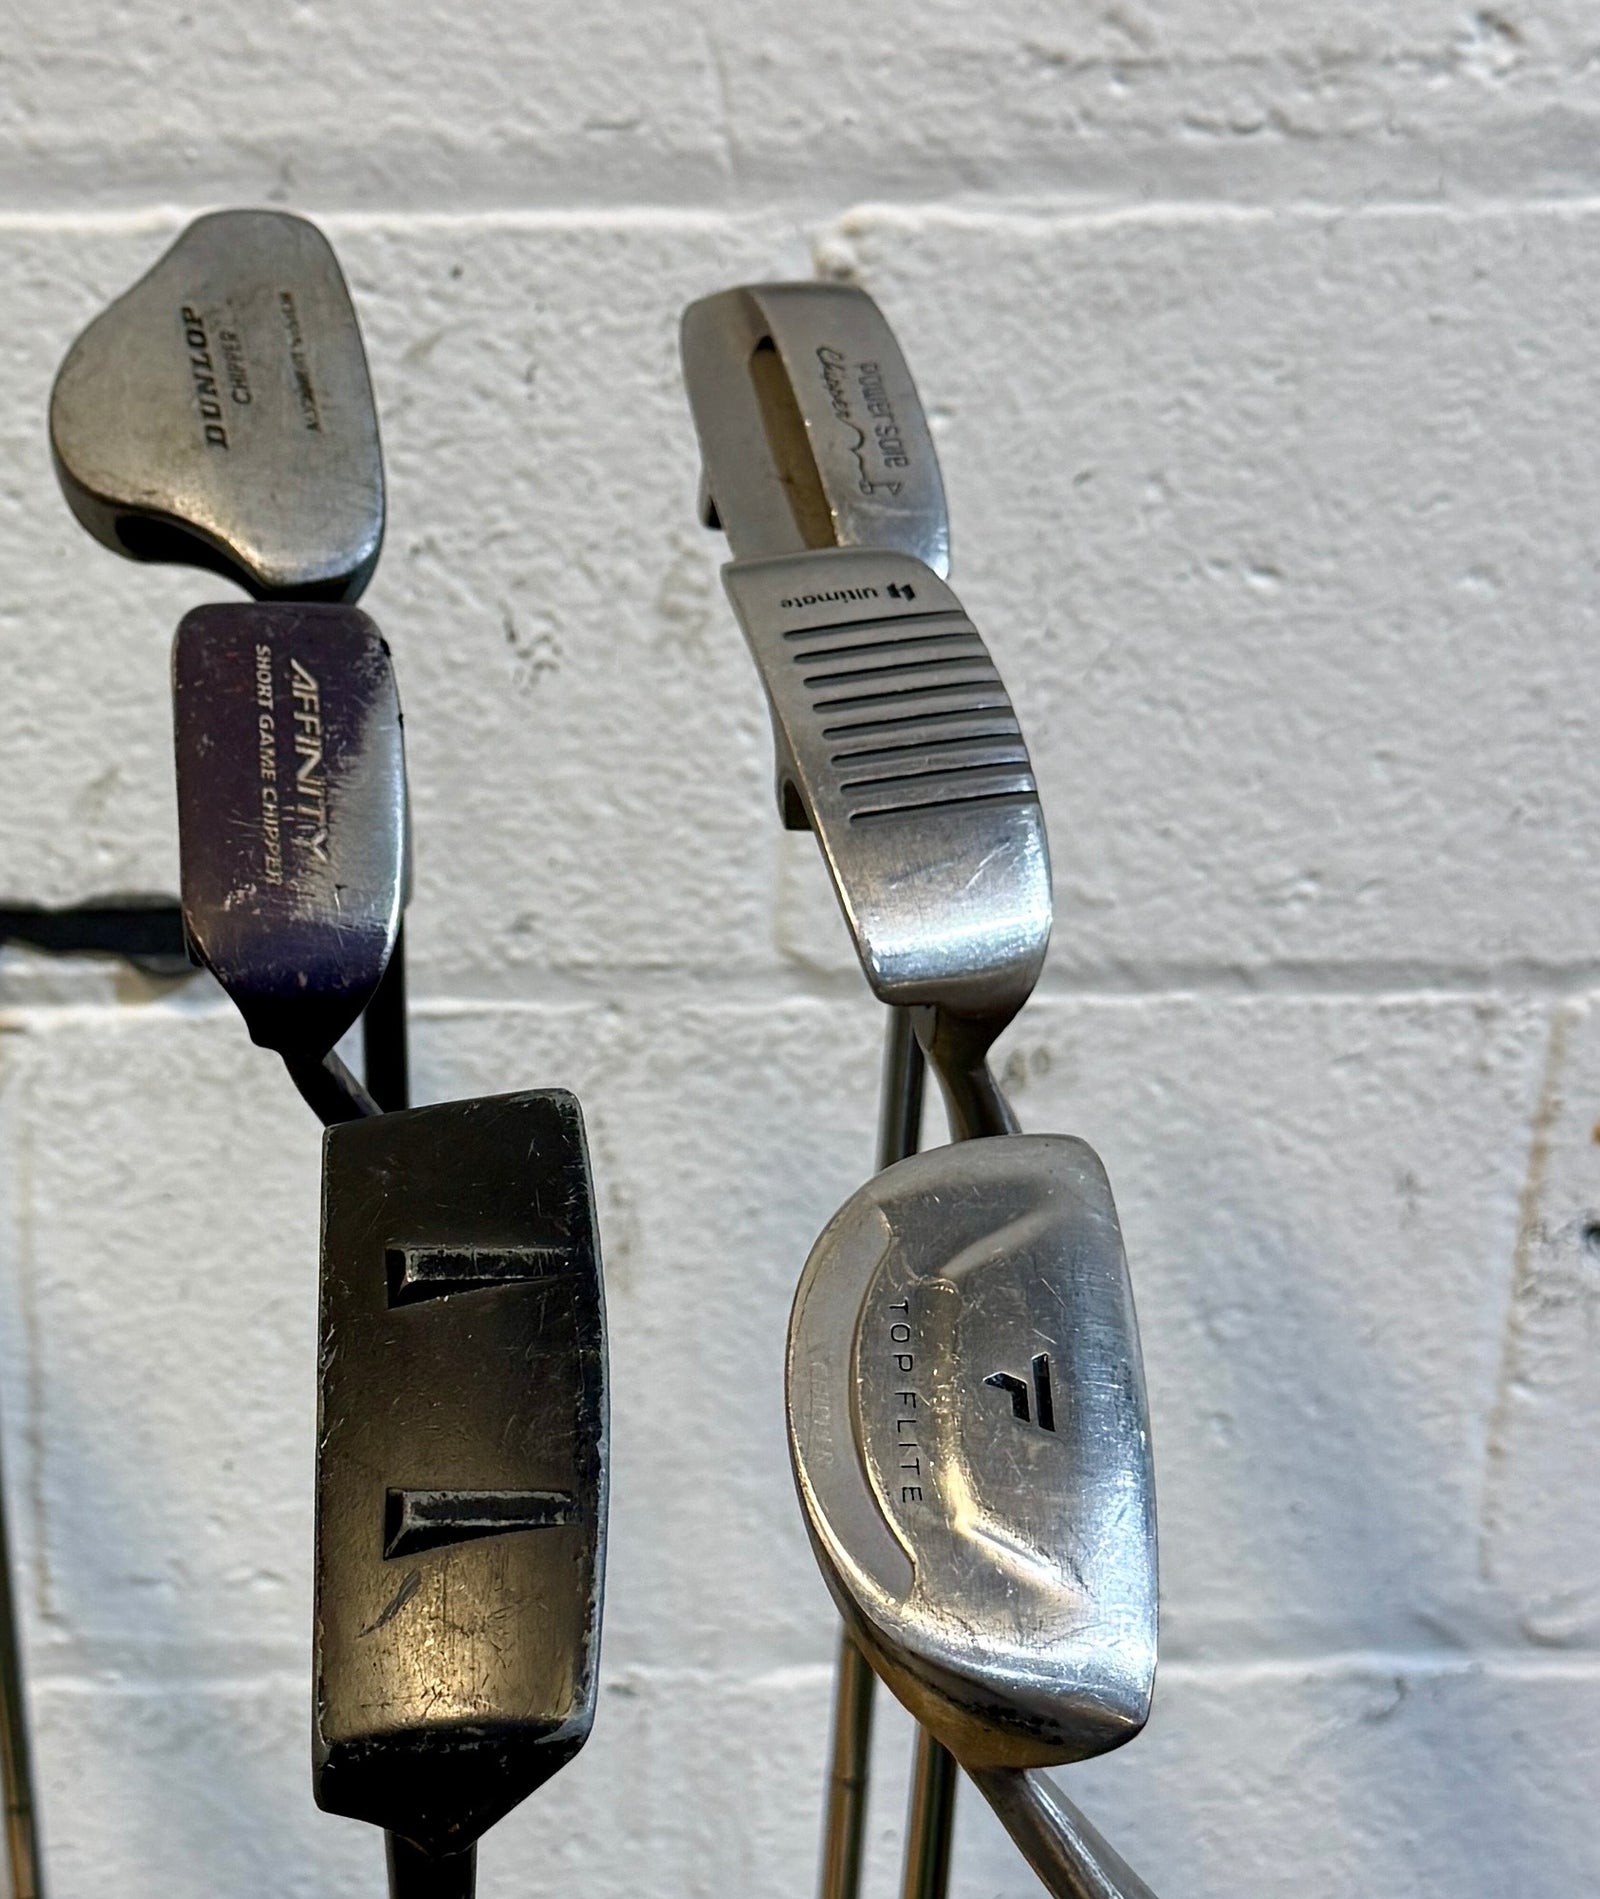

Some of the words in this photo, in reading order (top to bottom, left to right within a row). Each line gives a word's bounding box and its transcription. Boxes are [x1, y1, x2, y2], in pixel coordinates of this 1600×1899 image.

[181, 306, 229, 450] DUNLOP
[780, 587, 878, 608] ultimate
[256, 643, 274, 711] SHORT
[259, 714, 276, 781] GAME
[290, 657, 328, 864] AFFINITY
[262, 787, 283, 886] CHIPPER
[889, 1299, 914, 1372] TOP
[895, 1391, 922, 1503] FLITE
